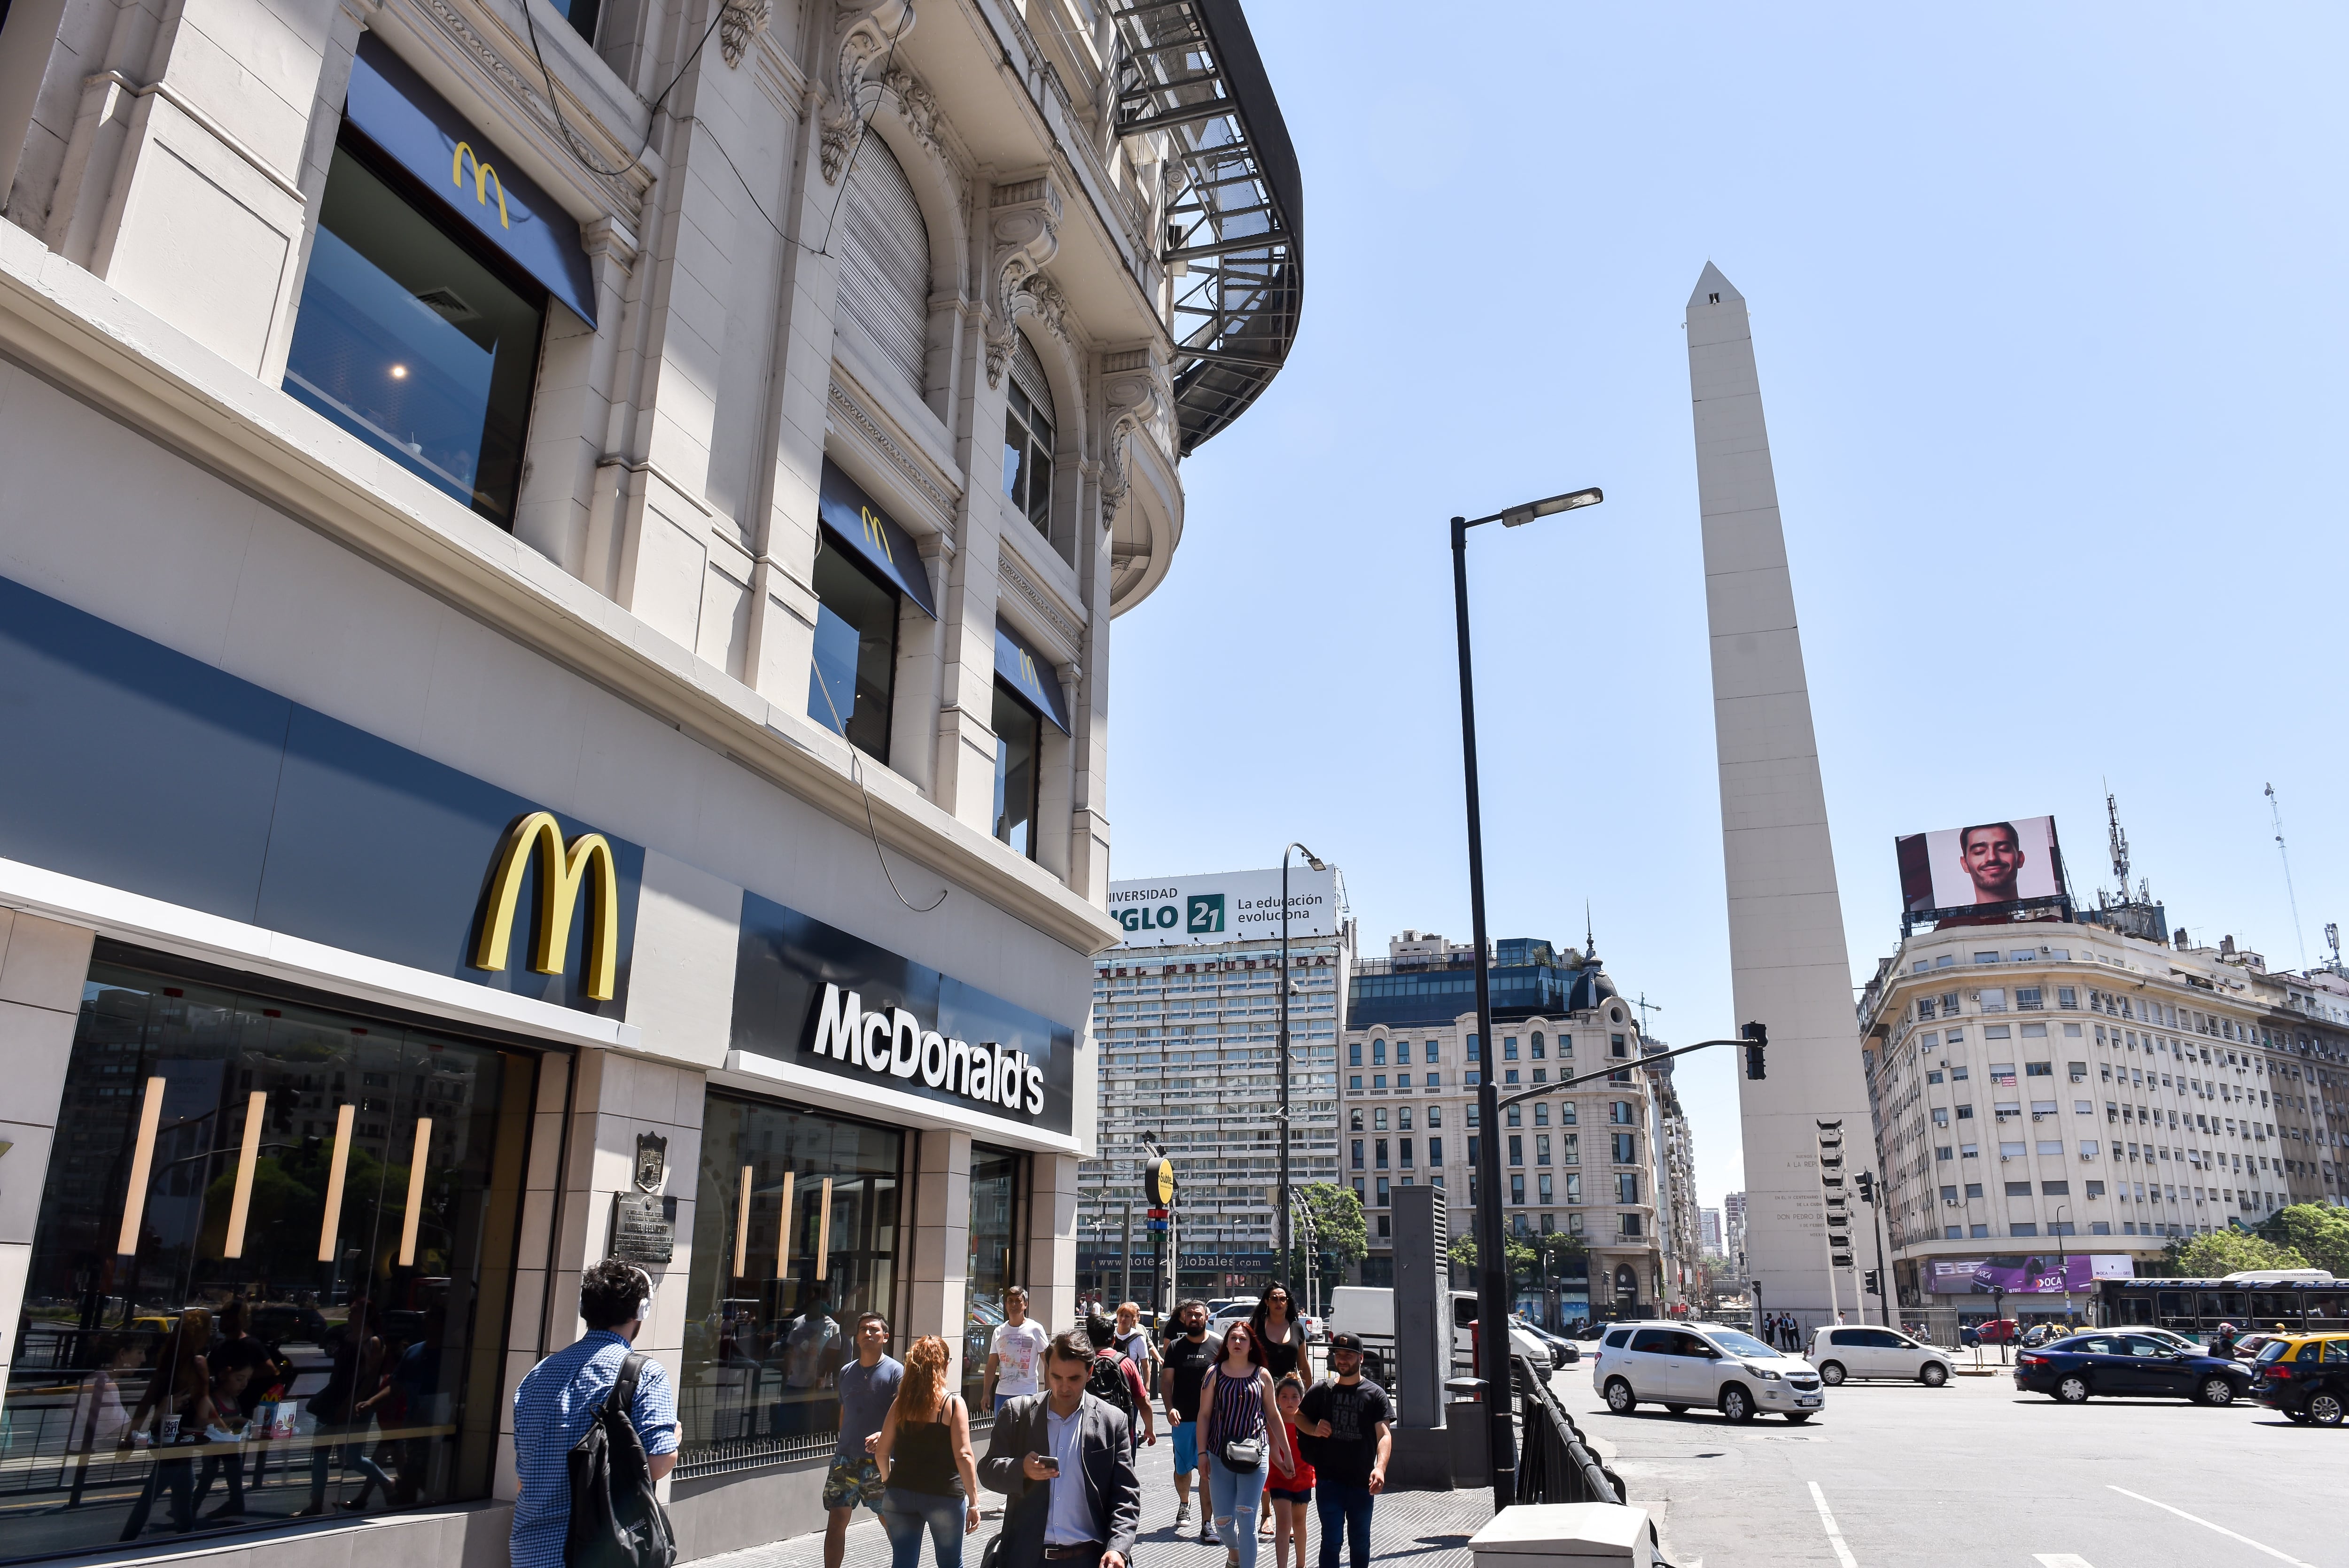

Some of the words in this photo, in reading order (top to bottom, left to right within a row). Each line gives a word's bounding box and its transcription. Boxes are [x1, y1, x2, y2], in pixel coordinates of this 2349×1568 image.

[1109, 888, 1178, 902] IVERSIDAD
[1238, 898, 1252, 909] La
[1191, 902, 1219, 931] 21
[1238, 909, 1310, 923] evoluciona
[1166, 956, 1327, 974] REPUBLCA
[813, 981, 1045, 1116] McDonald's
[1159, 1172, 1173, 1185] Subte
[2044, 1276, 2062, 1287] OCA
[2234, 1280, 2282, 1289] 17
